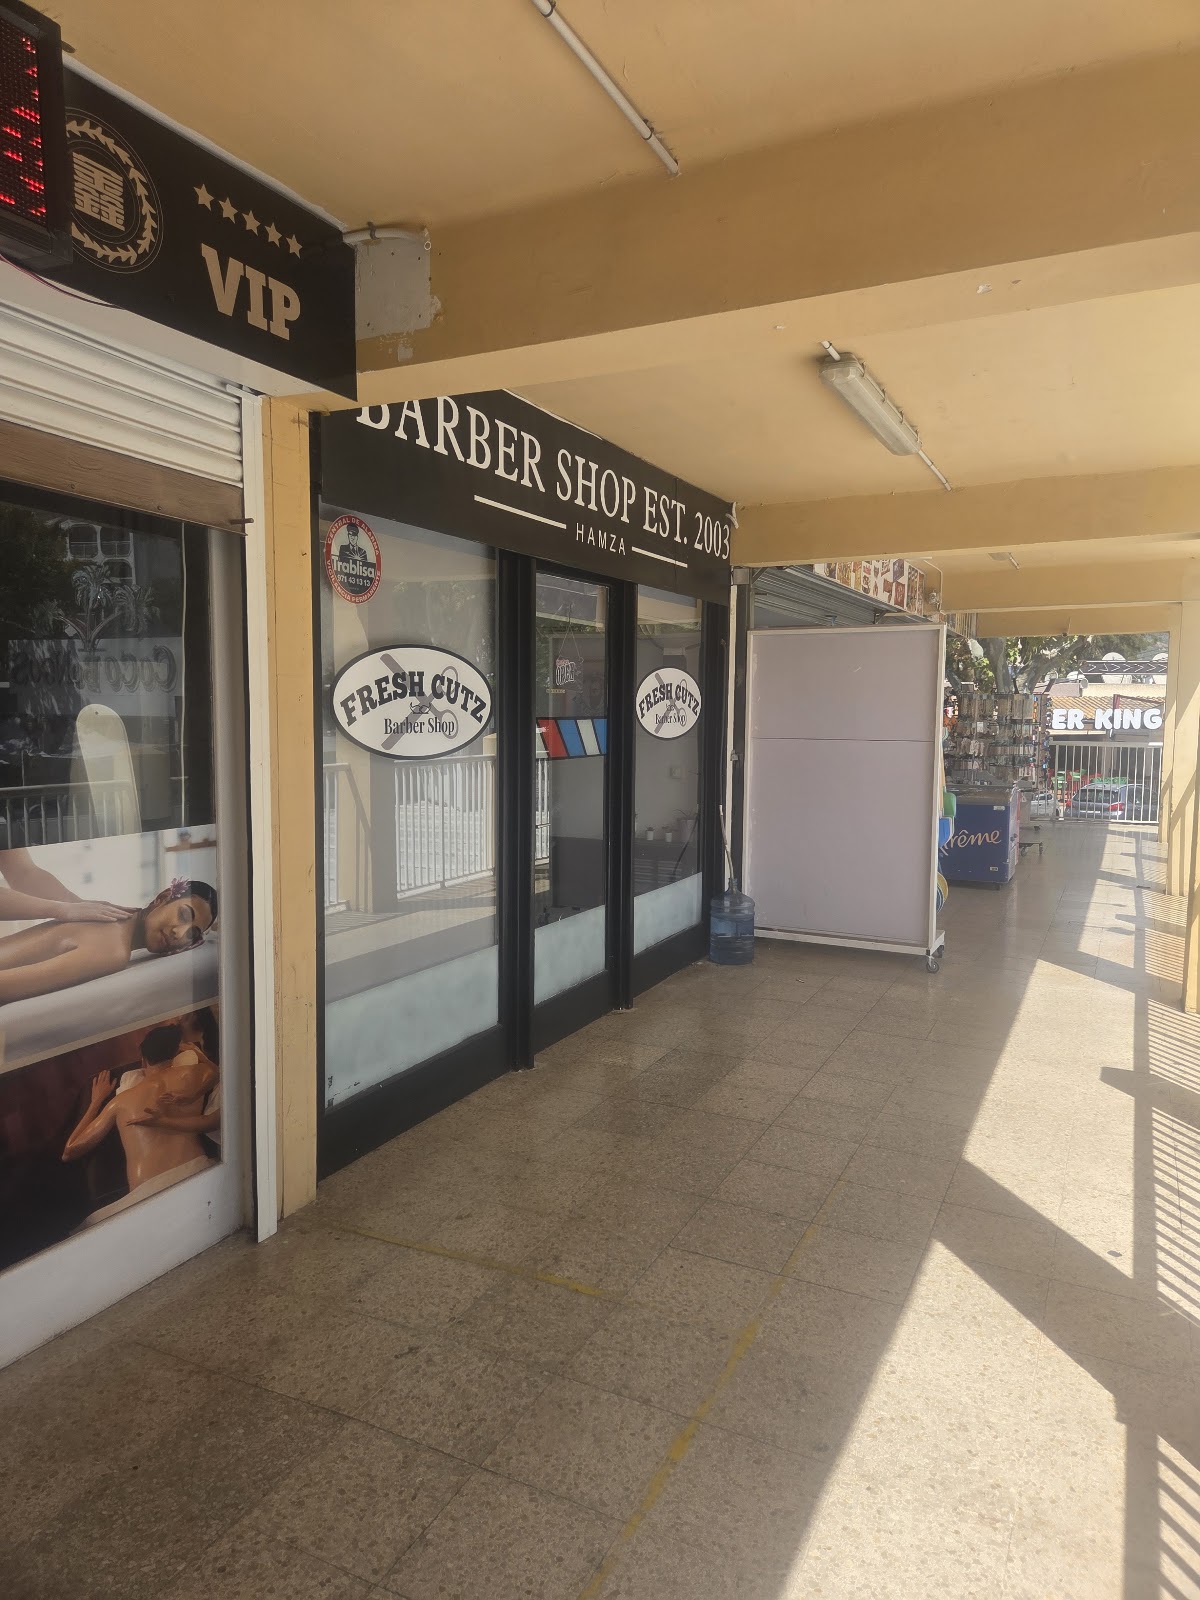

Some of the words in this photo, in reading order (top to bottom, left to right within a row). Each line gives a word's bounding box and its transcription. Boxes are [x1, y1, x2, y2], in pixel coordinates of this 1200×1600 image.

[201, 243, 301, 341] VIP
[556, 449, 636, 524] SHOP
[643, 487, 688, 545] EST.
[694, 512, 730, 560] 2003
[327, 517, 351, 544] CENTRAL
[351, 517, 361, 526] DE
[361, 523, 380, 556] ALARMA
[576, 523, 626, 555] HAMZA
[326, 559, 351, 602] VIGILANCIA
[351, 569, 381, 604] PERMANENTE
[332, 556, 375, 578] Trablisa
[337, 574, 348, 583] 971
[348, 576, 356, 585] 43
[356, 578, 363, 586] 13
[364, 579, 371, 587] 13
[340, 671, 425, 727] FRESH
[431, 673, 487, 724] CUTZ
[638, 682, 673, 719] FRESH
[675, 684, 700, 717] CUTZ
[384, 717, 425, 735] Barber
[427, 717, 455, 736] Shop
[1051, 708, 1085, 730] ER
[1094, 708, 1163, 730] KING
